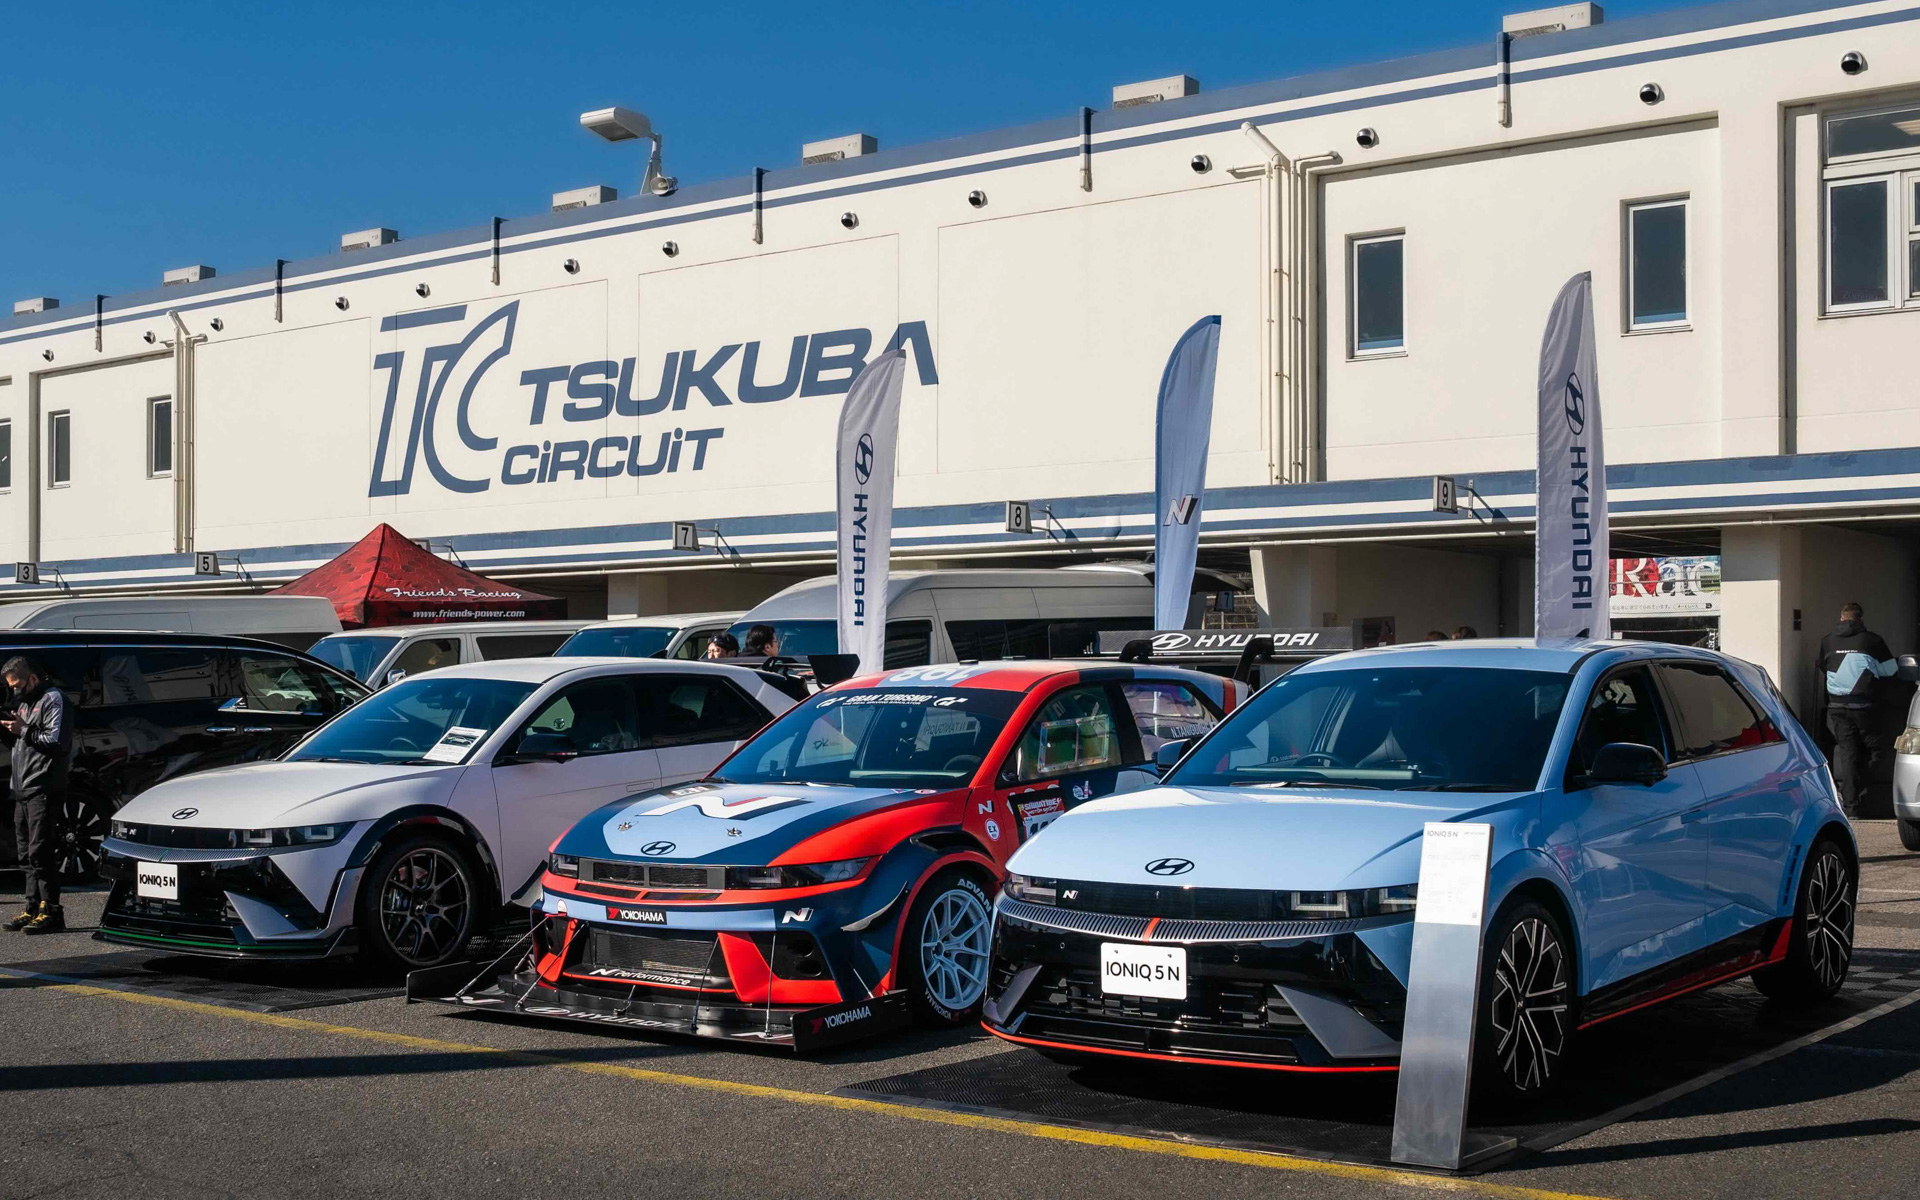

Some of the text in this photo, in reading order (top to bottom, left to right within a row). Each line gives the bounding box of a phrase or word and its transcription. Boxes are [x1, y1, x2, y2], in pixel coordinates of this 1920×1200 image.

[520, 320, 939, 423] TSUKUBA
[1441, 480, 1450, 506] 9
[1014, 506, 1023, 527] 8
[681, 526, 690, 546] 7
[1569, 446, 1593, 610] HYUNDAI
[202, 556, 210, 571] 5
[854, 493, 869, 627] HYUNDAI
[22, 566, 30, 580] 3
[385, 587, 522, 599] Friends Racing
[412, 609, 526, 619] www.friends-power.com
[1427, 830, 1447, 838] IONIQ
[139, 874, 176, 887] IONIQ 5 N
[957, 878, 992, 913] ADVAN
[620, 909, 664, 922] YOKOHAMA
[615, 970, 691, 986] Performance
[1106, 961, 1180, 982] IONIQ 5 N
[824, 1006, 872, 1029] YOKOHAMA
